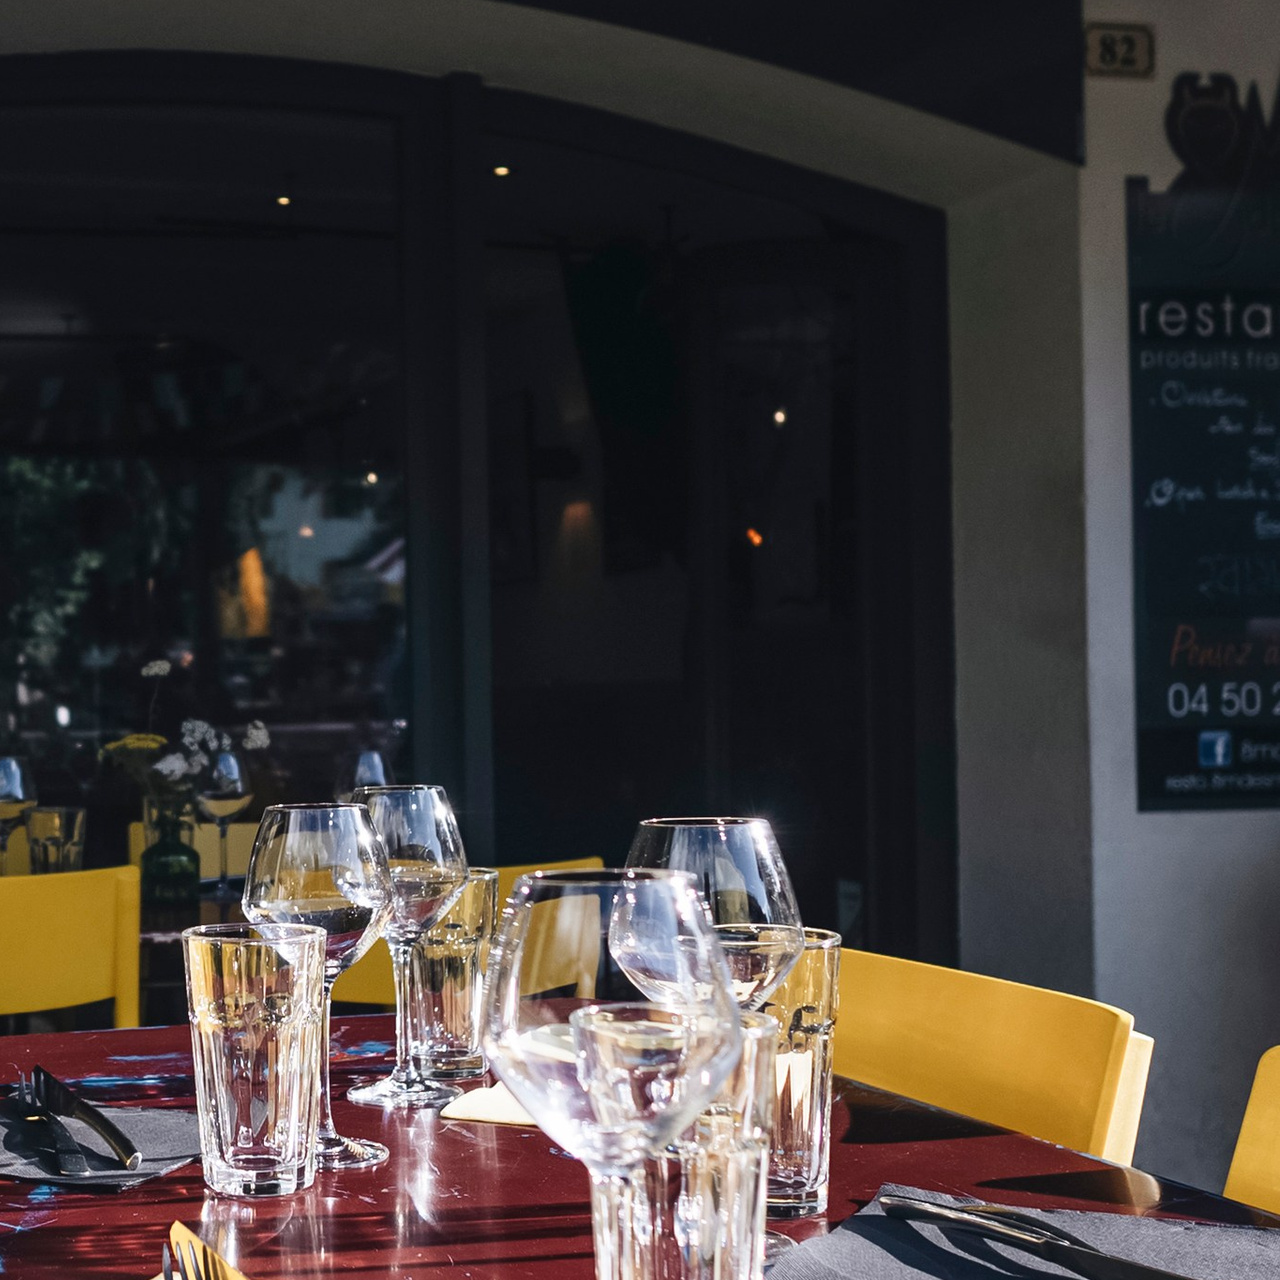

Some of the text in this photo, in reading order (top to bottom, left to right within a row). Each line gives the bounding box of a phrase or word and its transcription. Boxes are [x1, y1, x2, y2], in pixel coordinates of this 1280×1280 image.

[1099, 33, 1137, 67] 82
[1139, 294, 1274, 338] resta
[1140, 348, 1240, 370] produits
[1167, 681, 1209, 719] 04
[1220, 680, 1263, 718] 50
